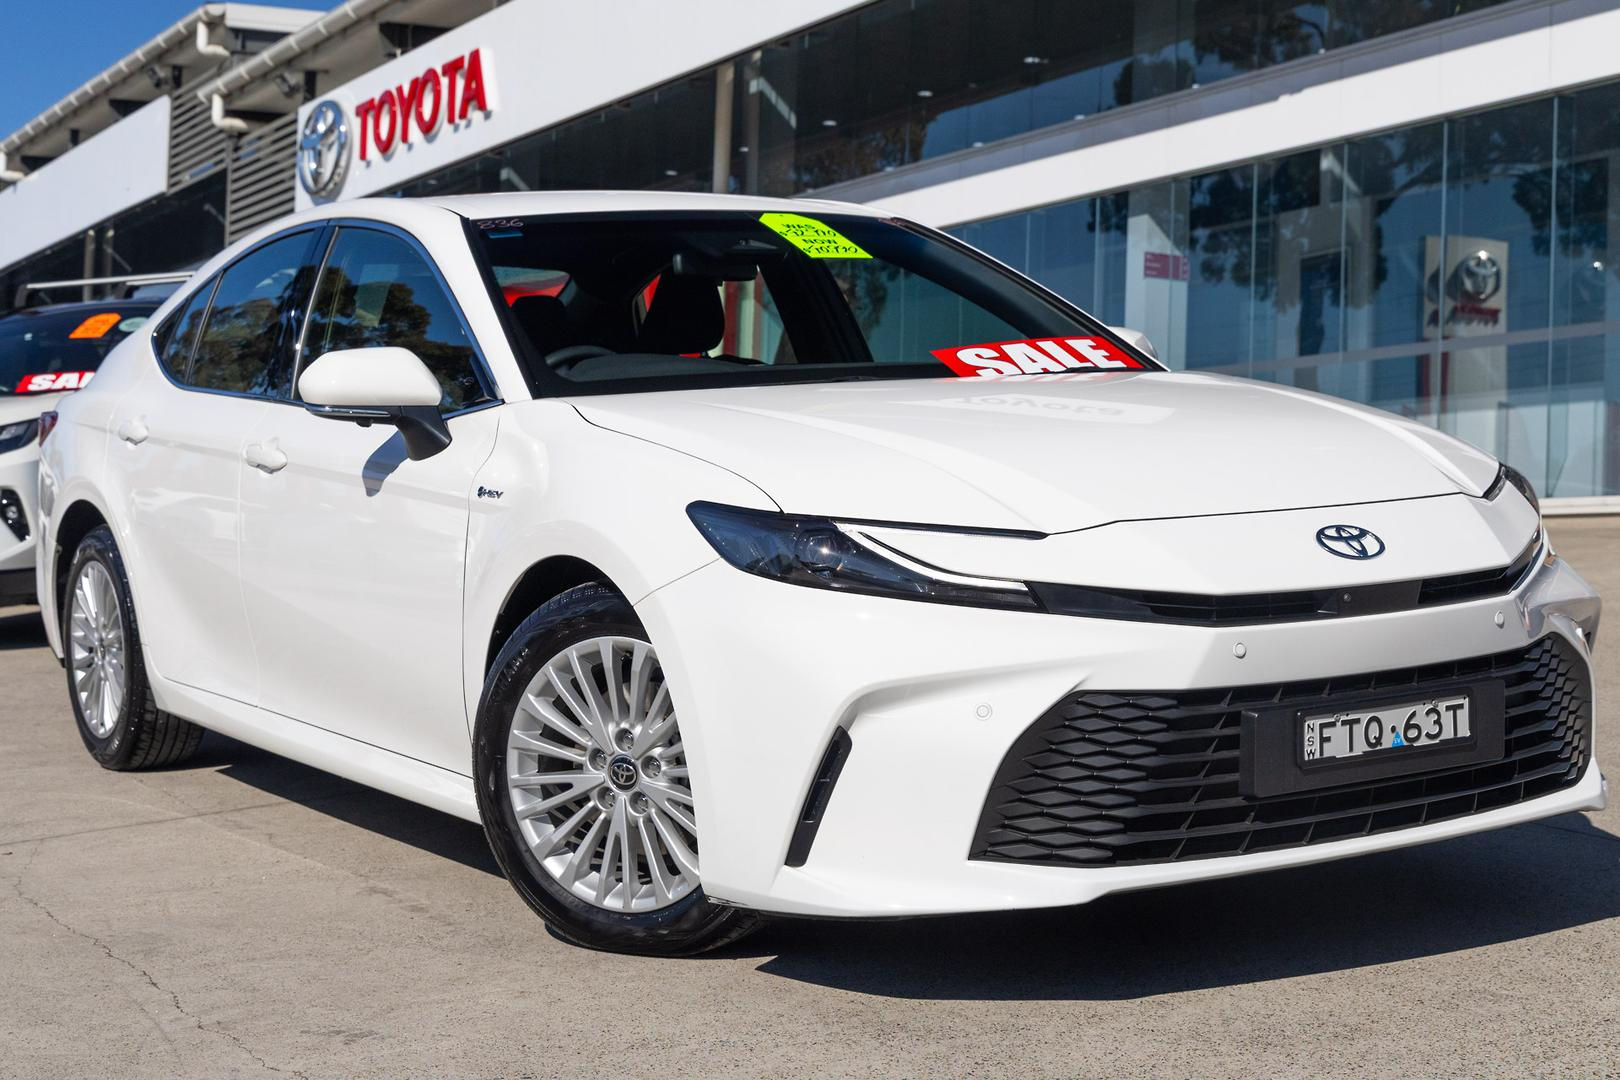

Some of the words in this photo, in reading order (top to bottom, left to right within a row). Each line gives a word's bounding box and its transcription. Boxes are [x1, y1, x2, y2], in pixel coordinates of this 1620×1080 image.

[355, 48, 487, 160] TOYOTA
[956, 339, 1127, 377] SALE
[1306, 722, 1317, 760] NSW
